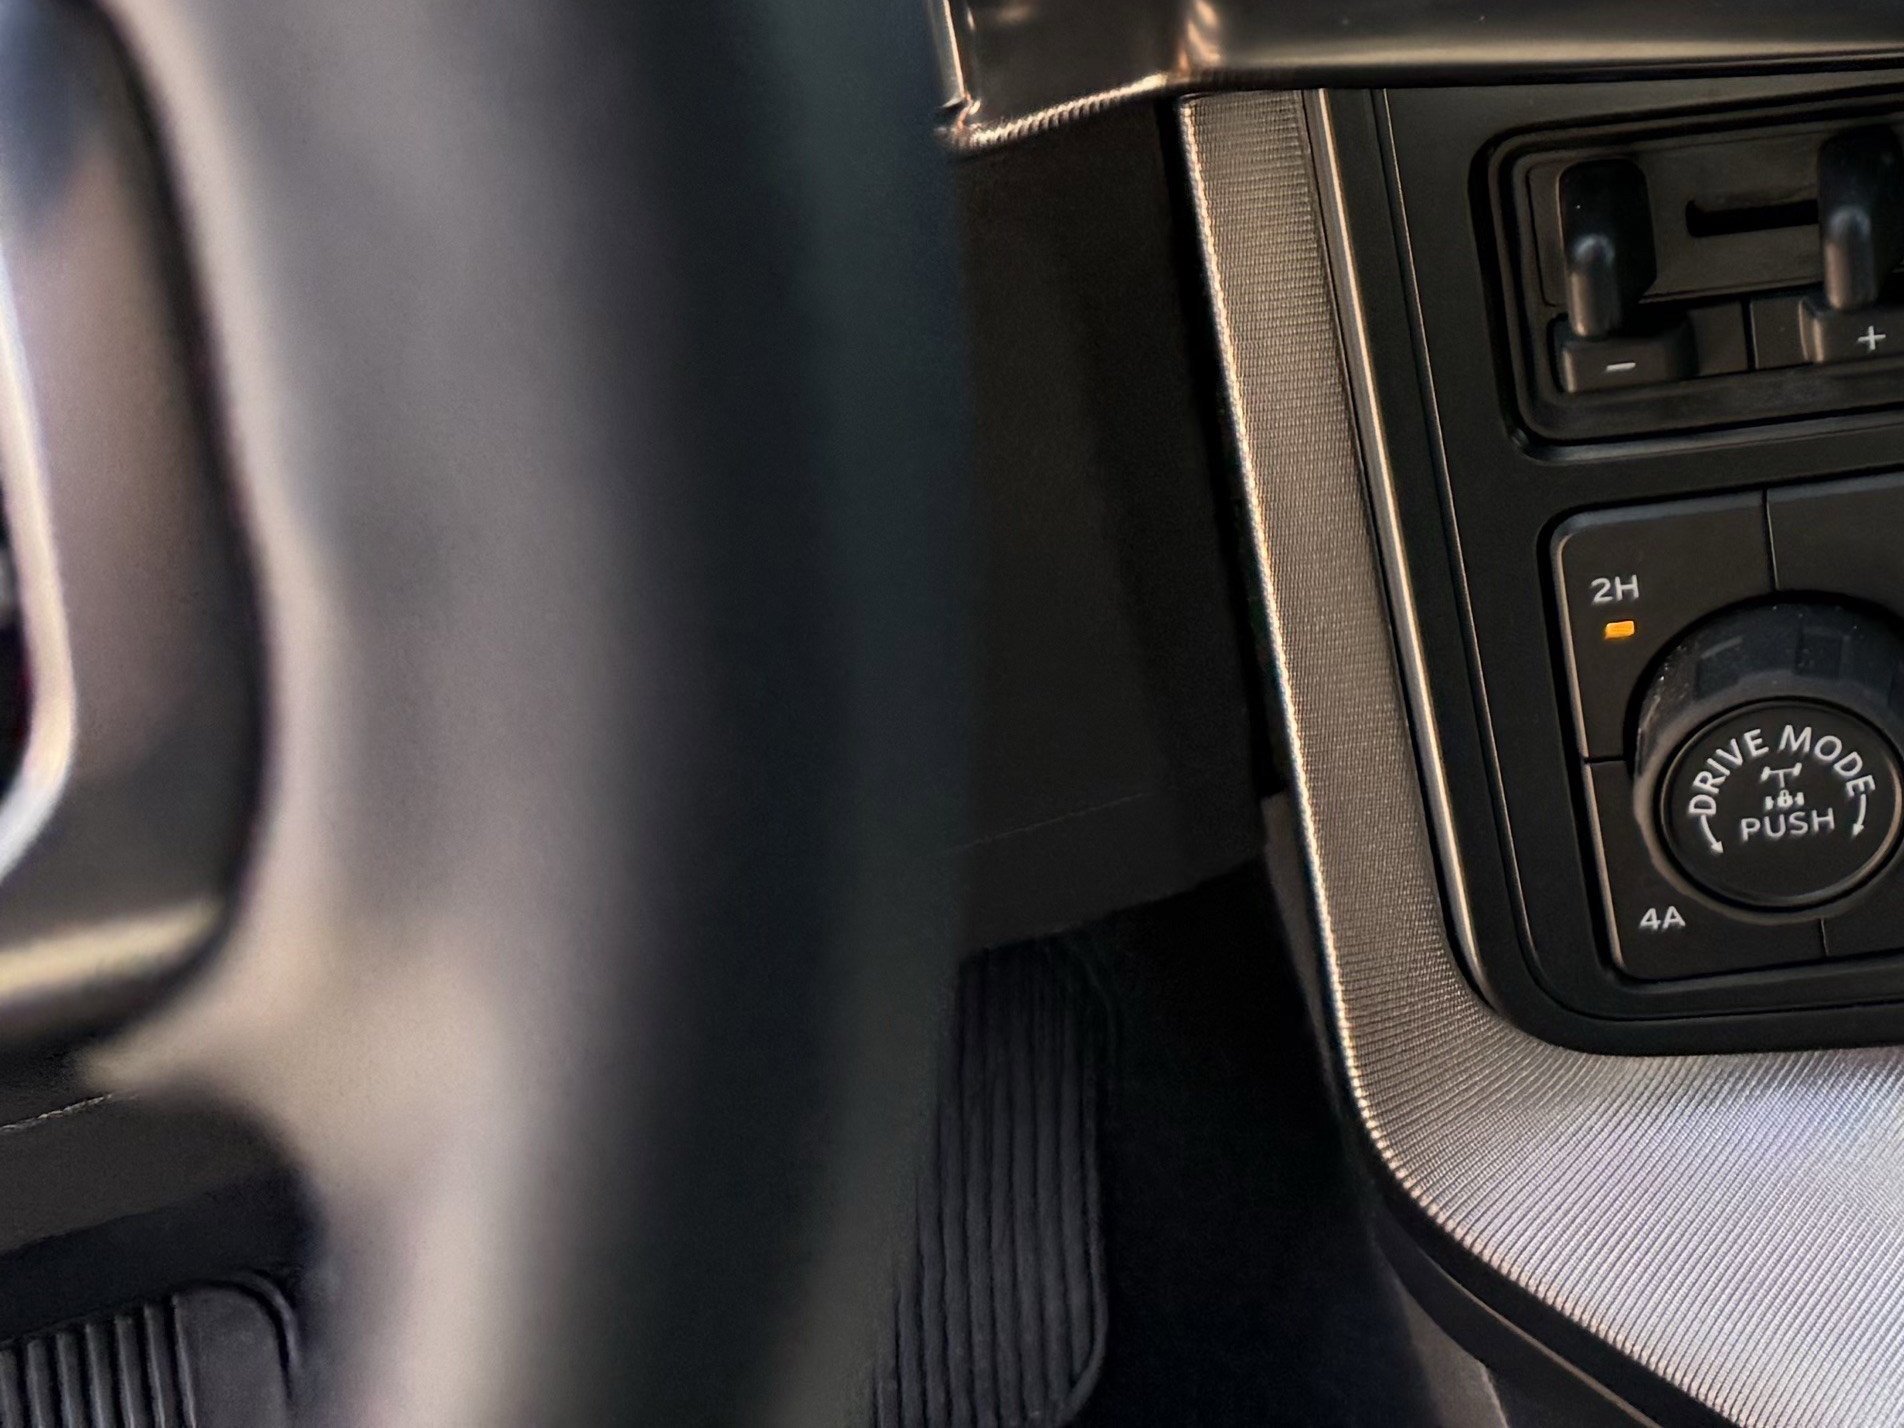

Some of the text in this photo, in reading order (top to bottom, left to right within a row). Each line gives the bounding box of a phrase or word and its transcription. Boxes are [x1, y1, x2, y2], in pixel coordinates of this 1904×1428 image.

[1591, 574, 1639, 604] 2H
[1687, 723, 1876, 818] DRIVE MODE
[1738, 806, 1835, 842] PUSH
[1639, 905, 1686, 930] 4A
